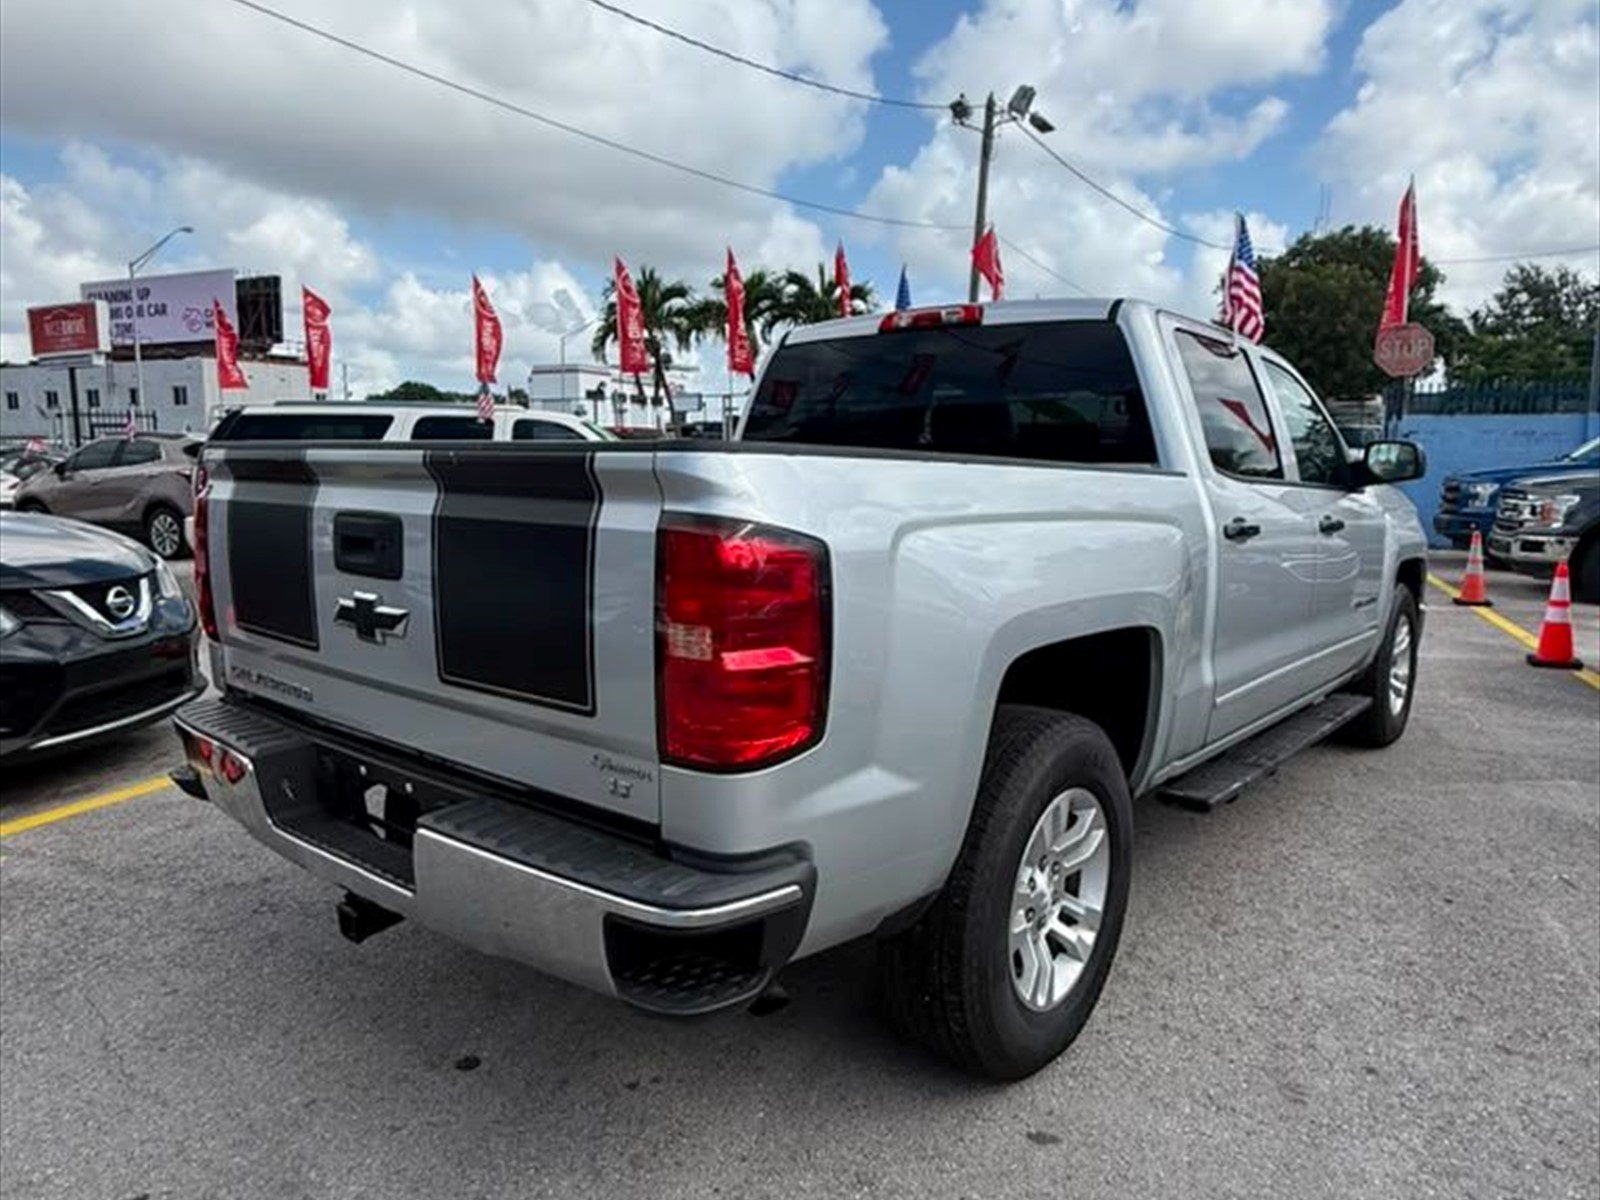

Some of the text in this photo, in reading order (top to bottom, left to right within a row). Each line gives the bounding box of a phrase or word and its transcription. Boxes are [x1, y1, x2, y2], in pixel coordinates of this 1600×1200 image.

[136, 286, 151, 301] UP
[147, 302, 168, 317] CAR
[1380, 338, 1429, 360] STOP
